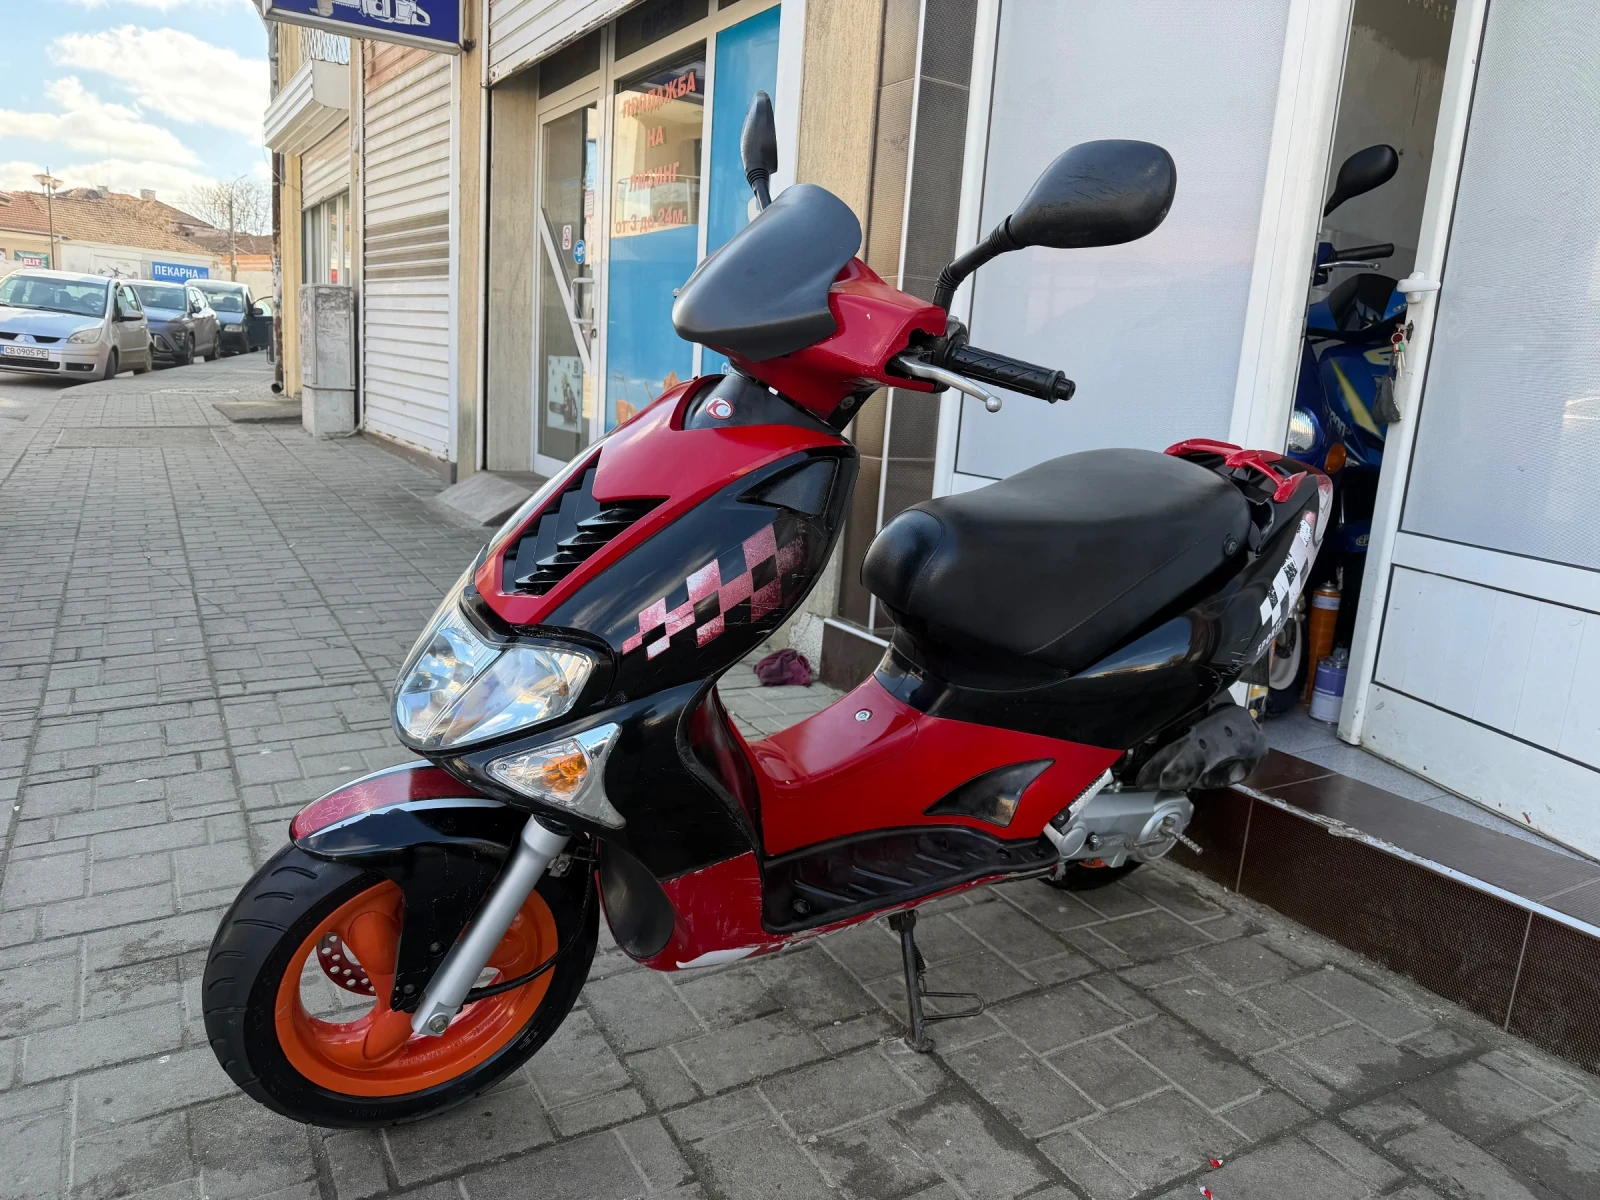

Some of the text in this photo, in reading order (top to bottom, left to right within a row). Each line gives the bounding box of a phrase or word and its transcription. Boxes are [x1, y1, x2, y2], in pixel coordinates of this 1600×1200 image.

[622, 71, 696, 118] ПРОДАЖБА
[647, 125, 664, 148] НА
[629, 161, 680, 192] ЛИЗИНГ
[630, 213, 638, 232] 3
[640, 215, 655, 233] до
[24, 257, 41, 267] ELIT
[154, 264, 199, 279] ПЕКАРНА
[16, 348, 35, 357] 0905
